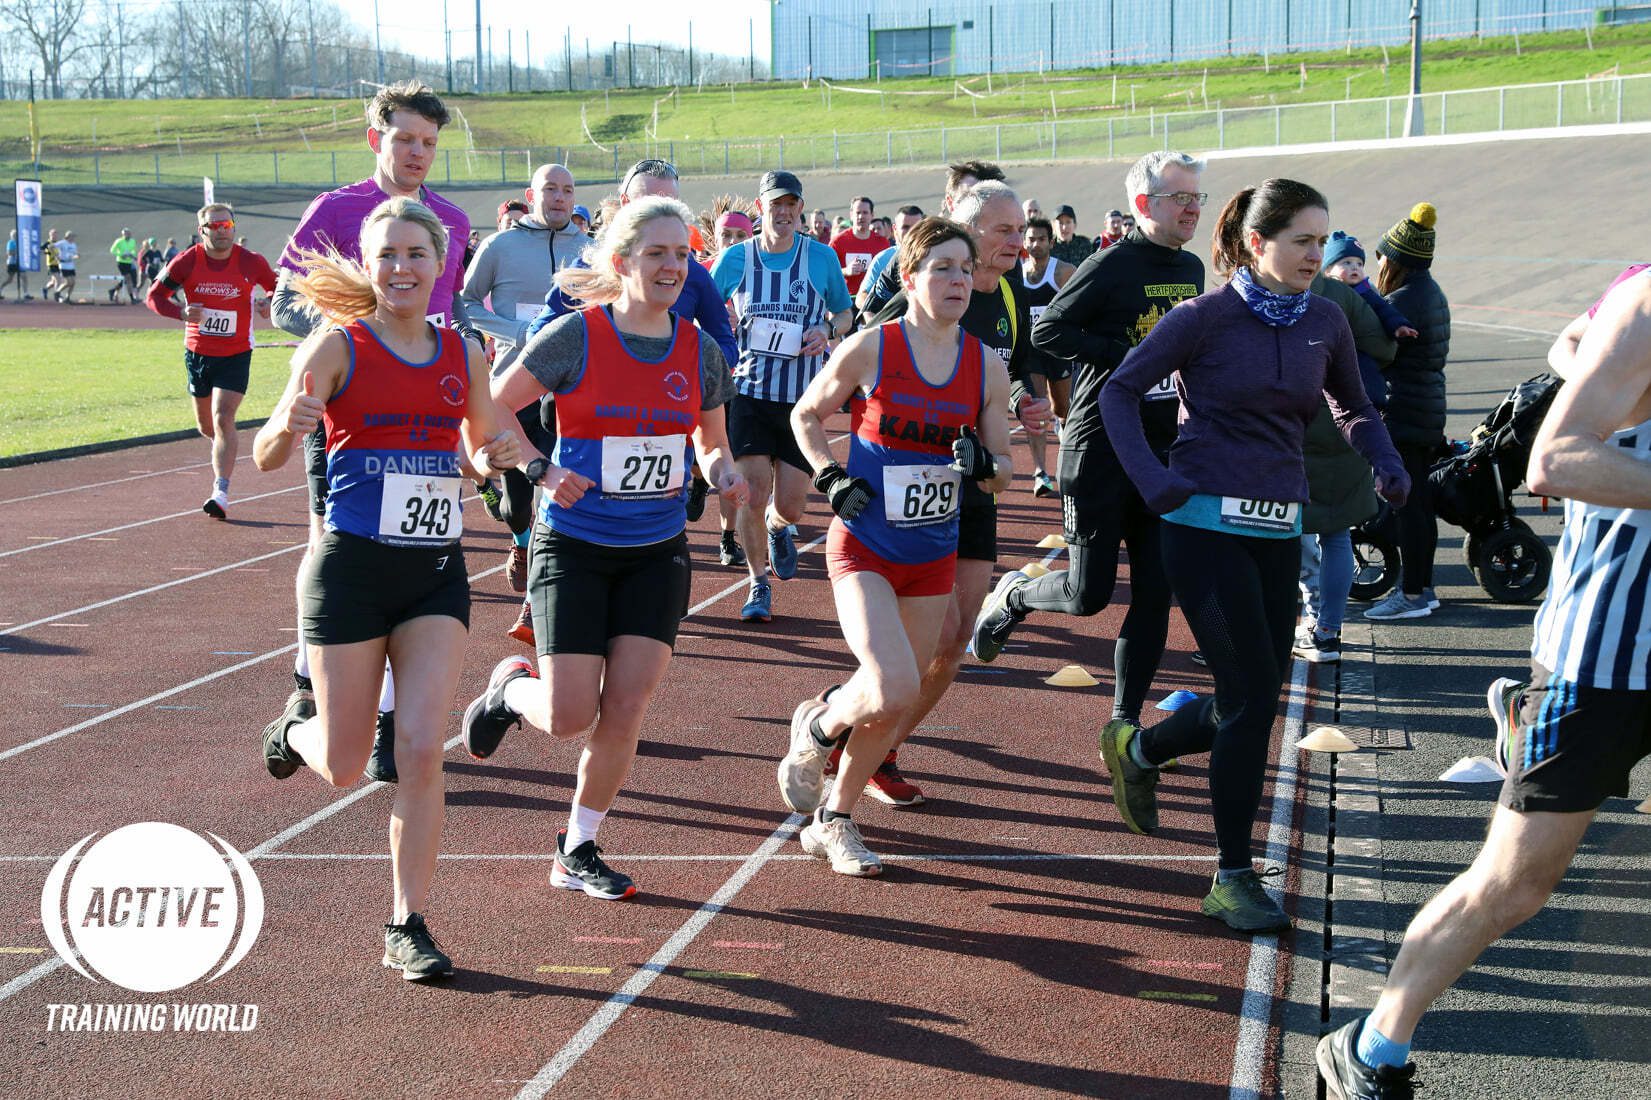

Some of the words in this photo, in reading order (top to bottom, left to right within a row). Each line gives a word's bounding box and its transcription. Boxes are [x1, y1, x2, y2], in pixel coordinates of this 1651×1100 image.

[194, 287, 231, 295] ARROWS
[783, 303, 807, 314] VALLEY
[204, 317, 230, 332] 440
[768, 331, 783, 351] 11
[879, 414, 960, 447] KARE
[620, 454, 672, 490] 279
[903, 482, 954, 518] 629
[400, 496, 451, 536] 343
